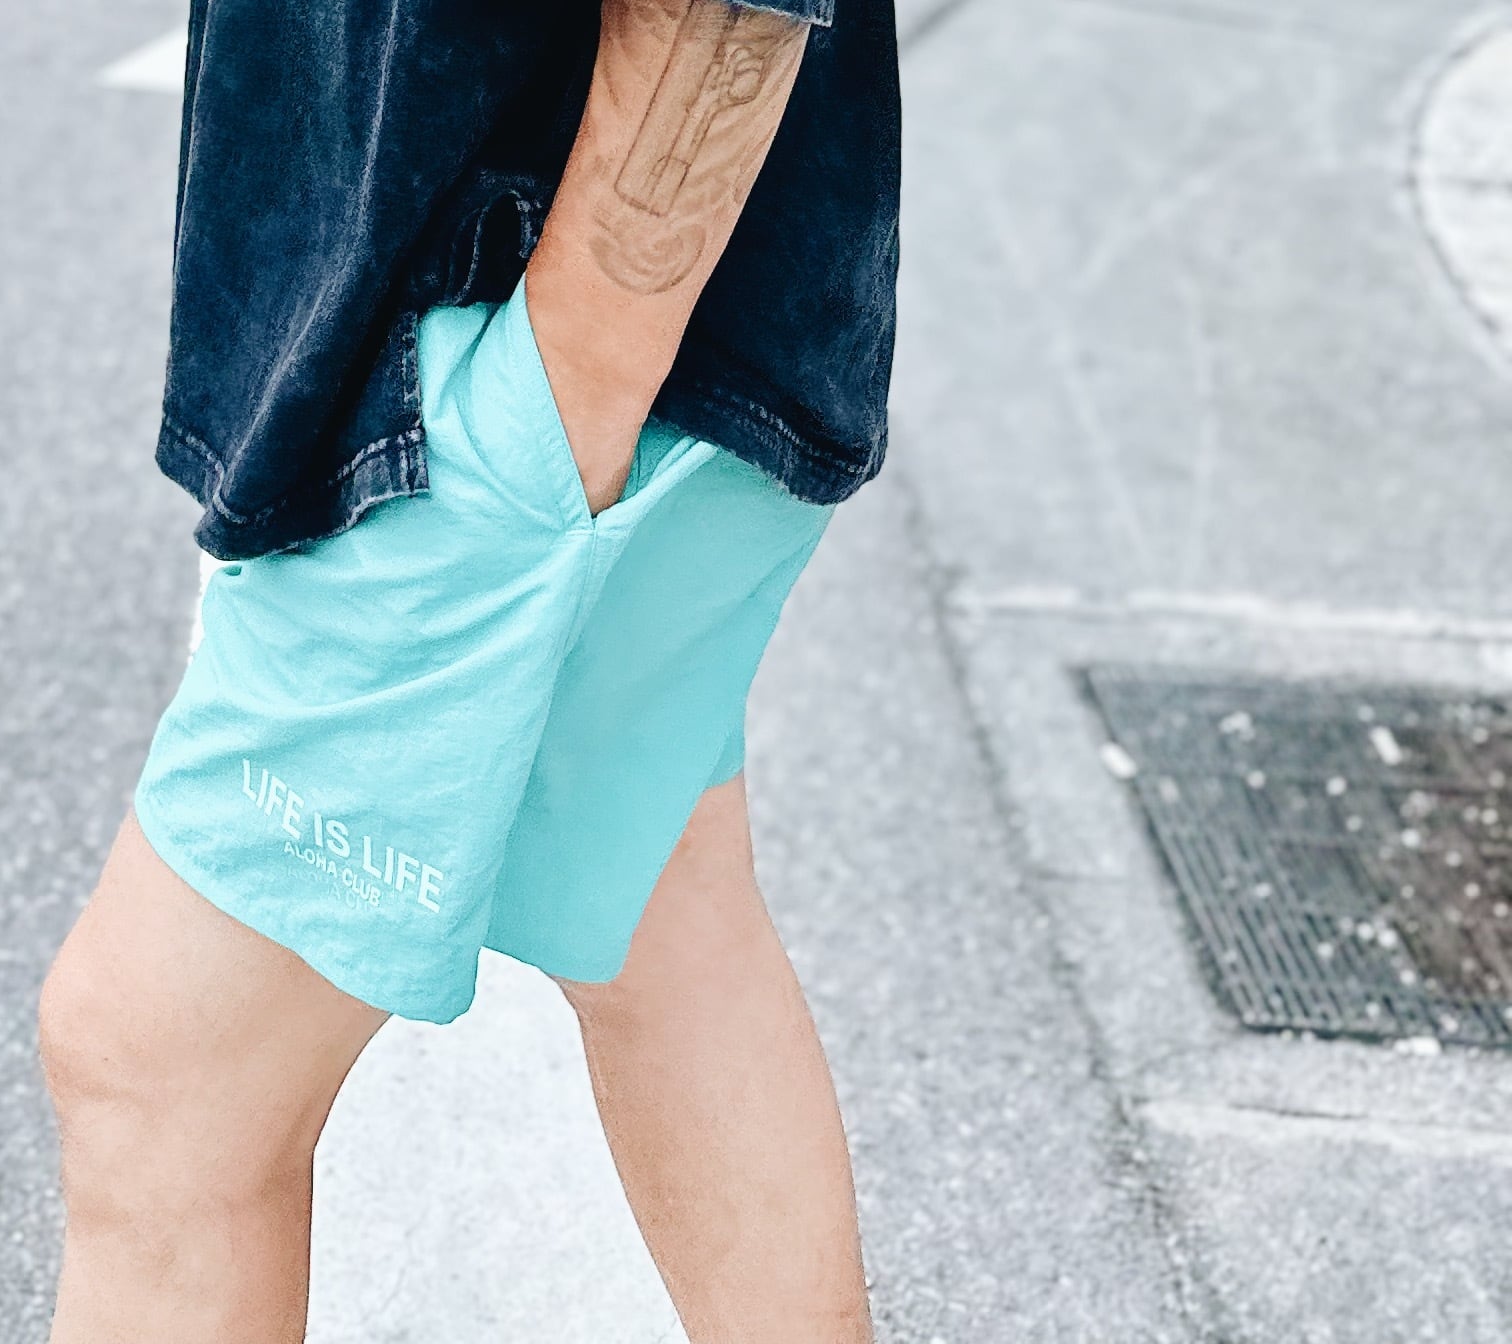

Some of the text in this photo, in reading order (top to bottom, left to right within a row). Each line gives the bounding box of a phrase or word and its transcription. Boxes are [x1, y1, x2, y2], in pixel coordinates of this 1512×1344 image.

[243, 759, 444, 913] LIFE IS LIFE
[284, 841, 381, 906] ALOHA CLUB
